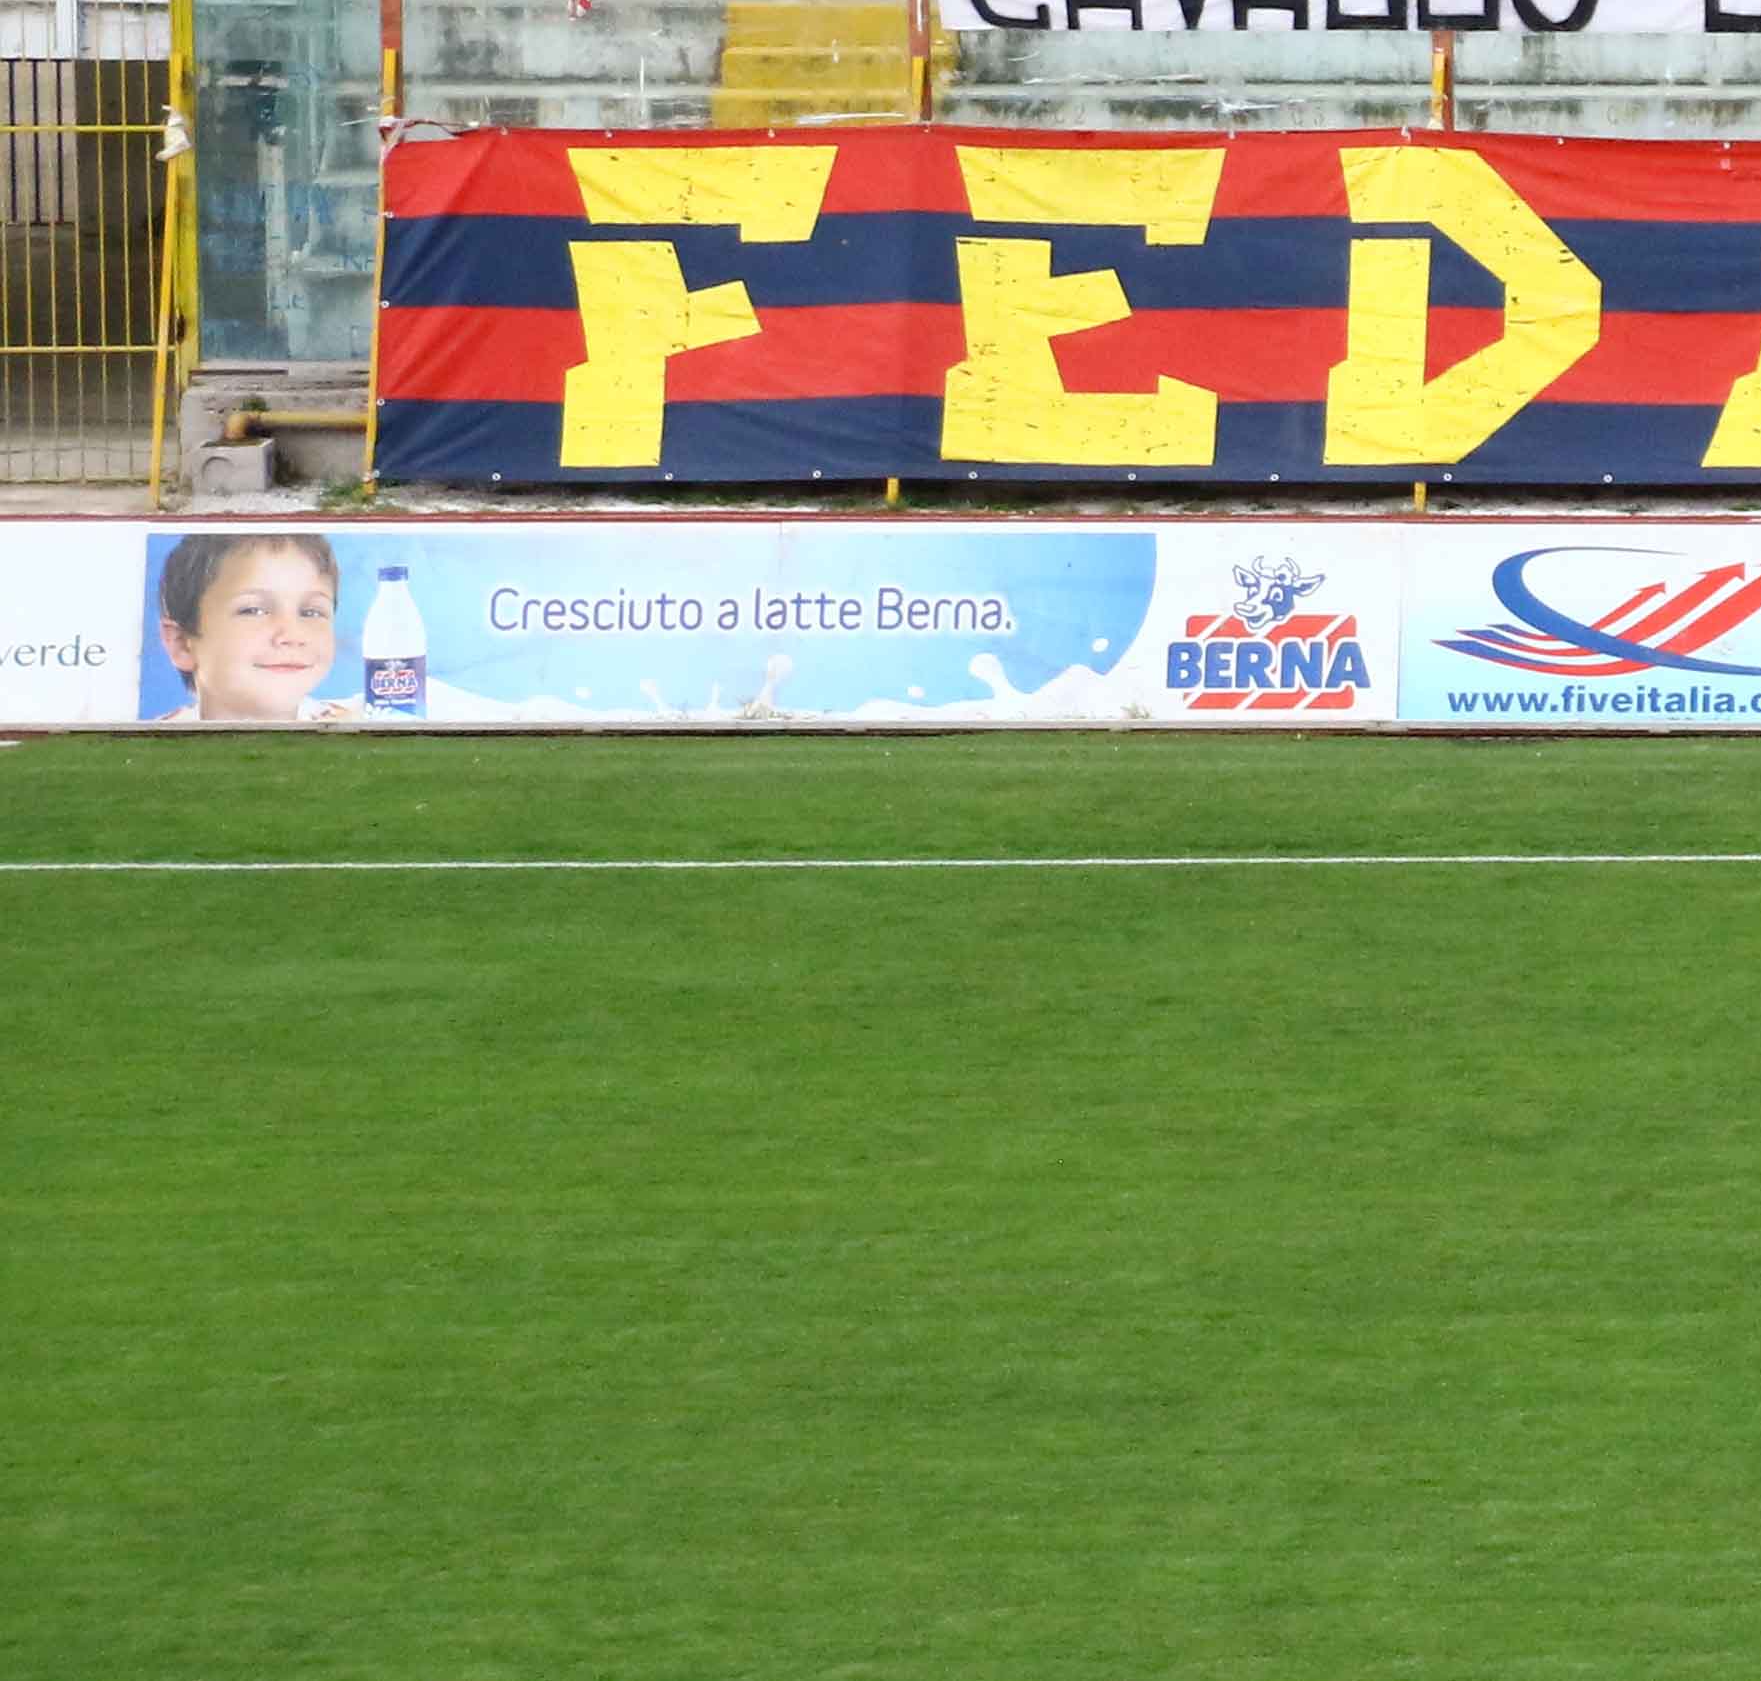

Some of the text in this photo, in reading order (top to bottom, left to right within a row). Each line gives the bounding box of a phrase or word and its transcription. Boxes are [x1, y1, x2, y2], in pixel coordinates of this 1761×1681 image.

[489, 586, 1013, 632] Cresciuto a latte Berna.
[1166, 638, 1371, 692] BERNA
